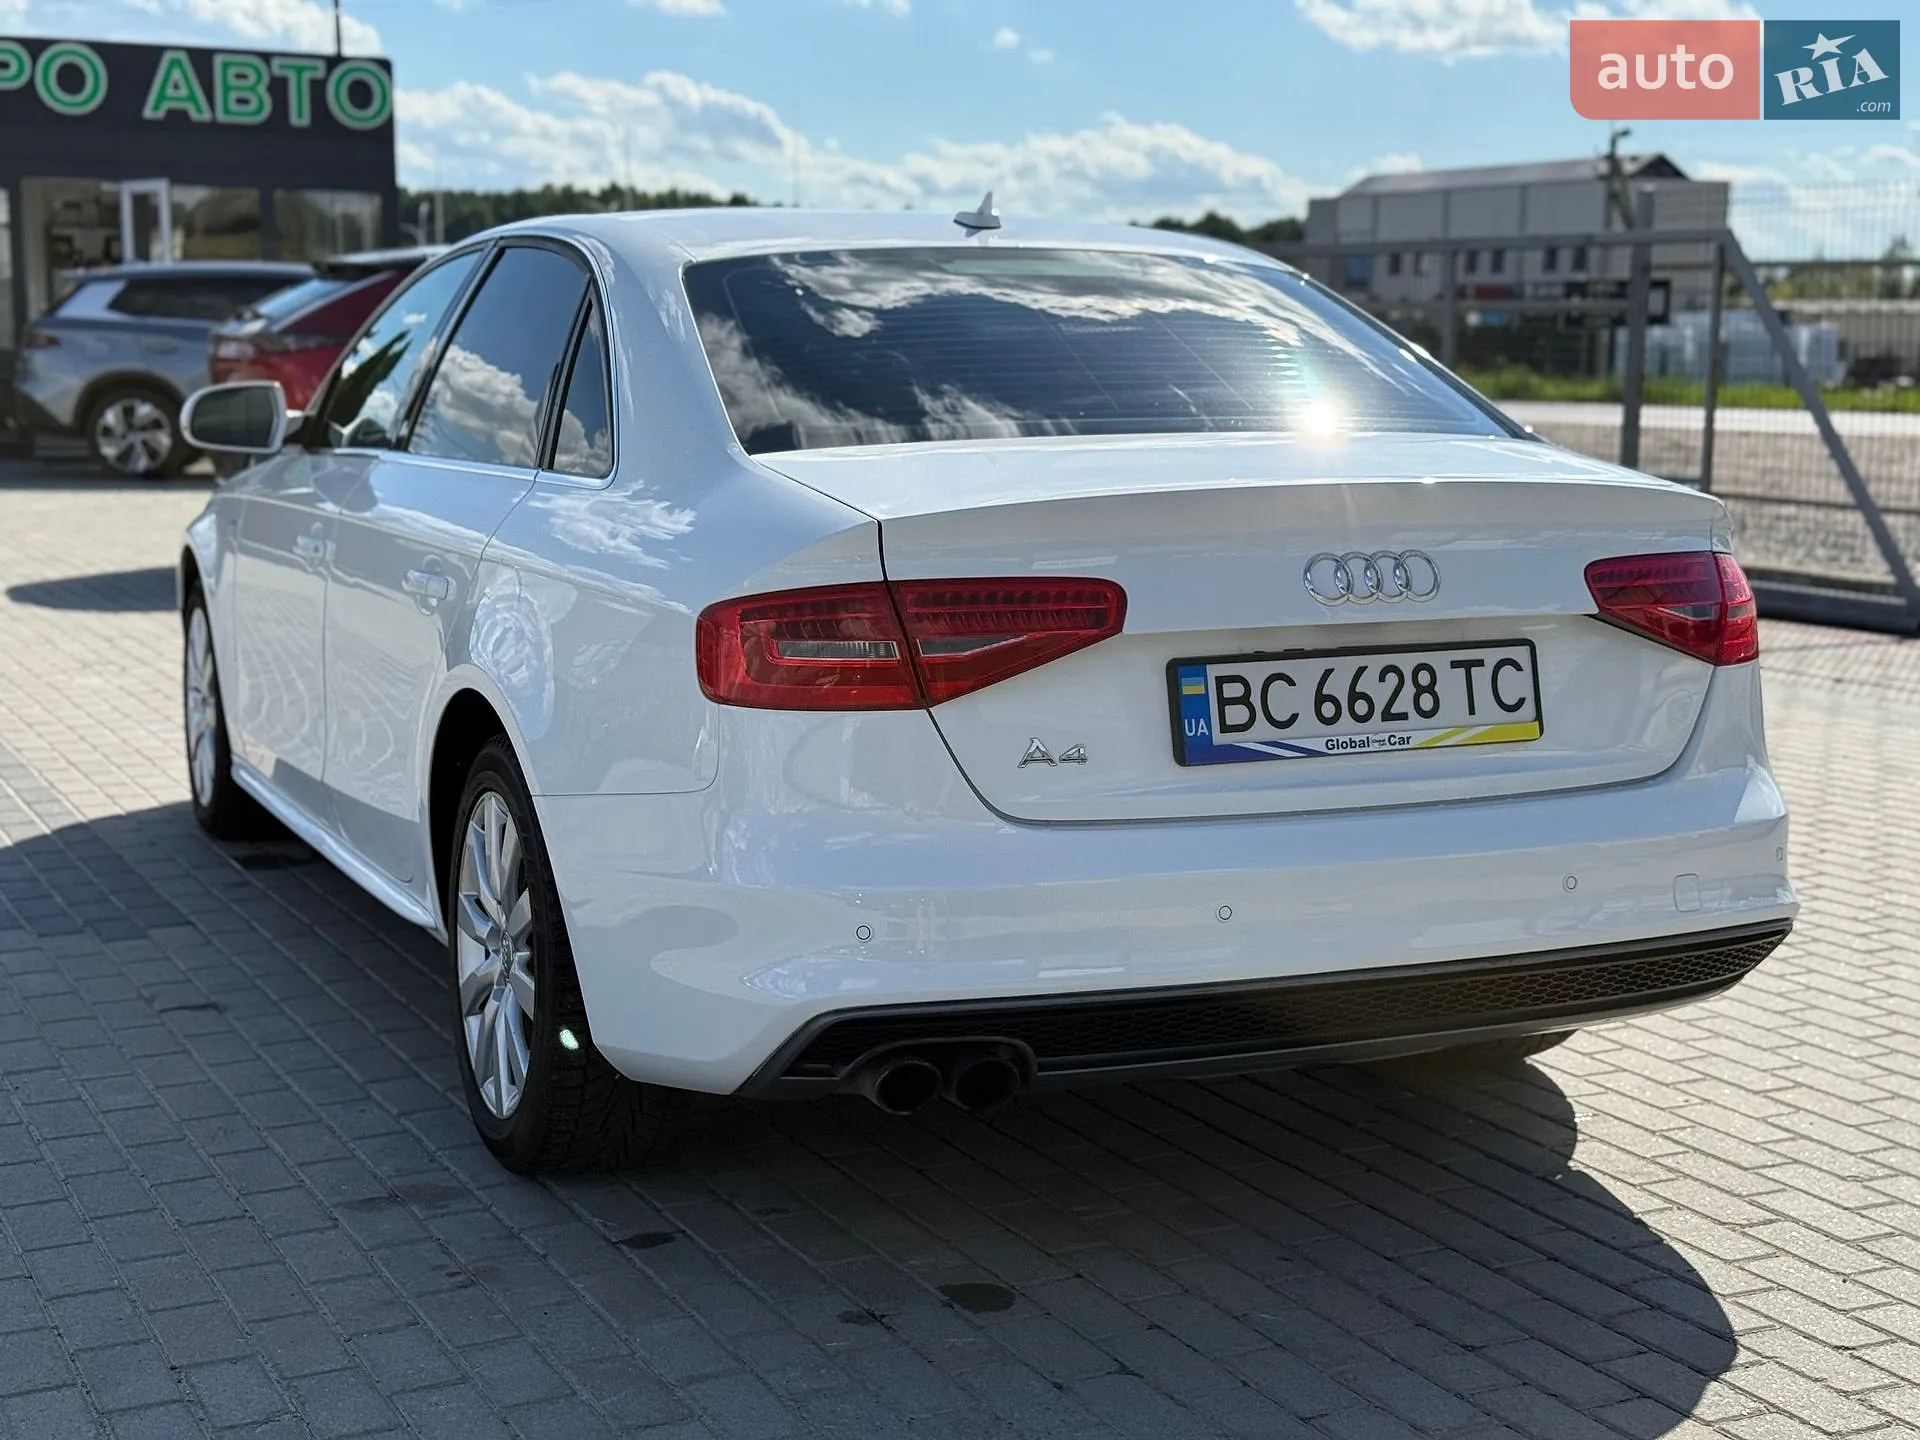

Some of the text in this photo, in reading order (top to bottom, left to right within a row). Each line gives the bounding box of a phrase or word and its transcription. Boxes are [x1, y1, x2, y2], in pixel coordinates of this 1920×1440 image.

[142, 50, 393, 130] АВТО
[1215, 657, 1526, 734] BC 6628 TC
[1184, 718, 1209, 736] UA
[1325, 736, 1370, 750] Global
[1387, 734, 1411, 746] Car
[1017, 737, 1088, 768] A4
